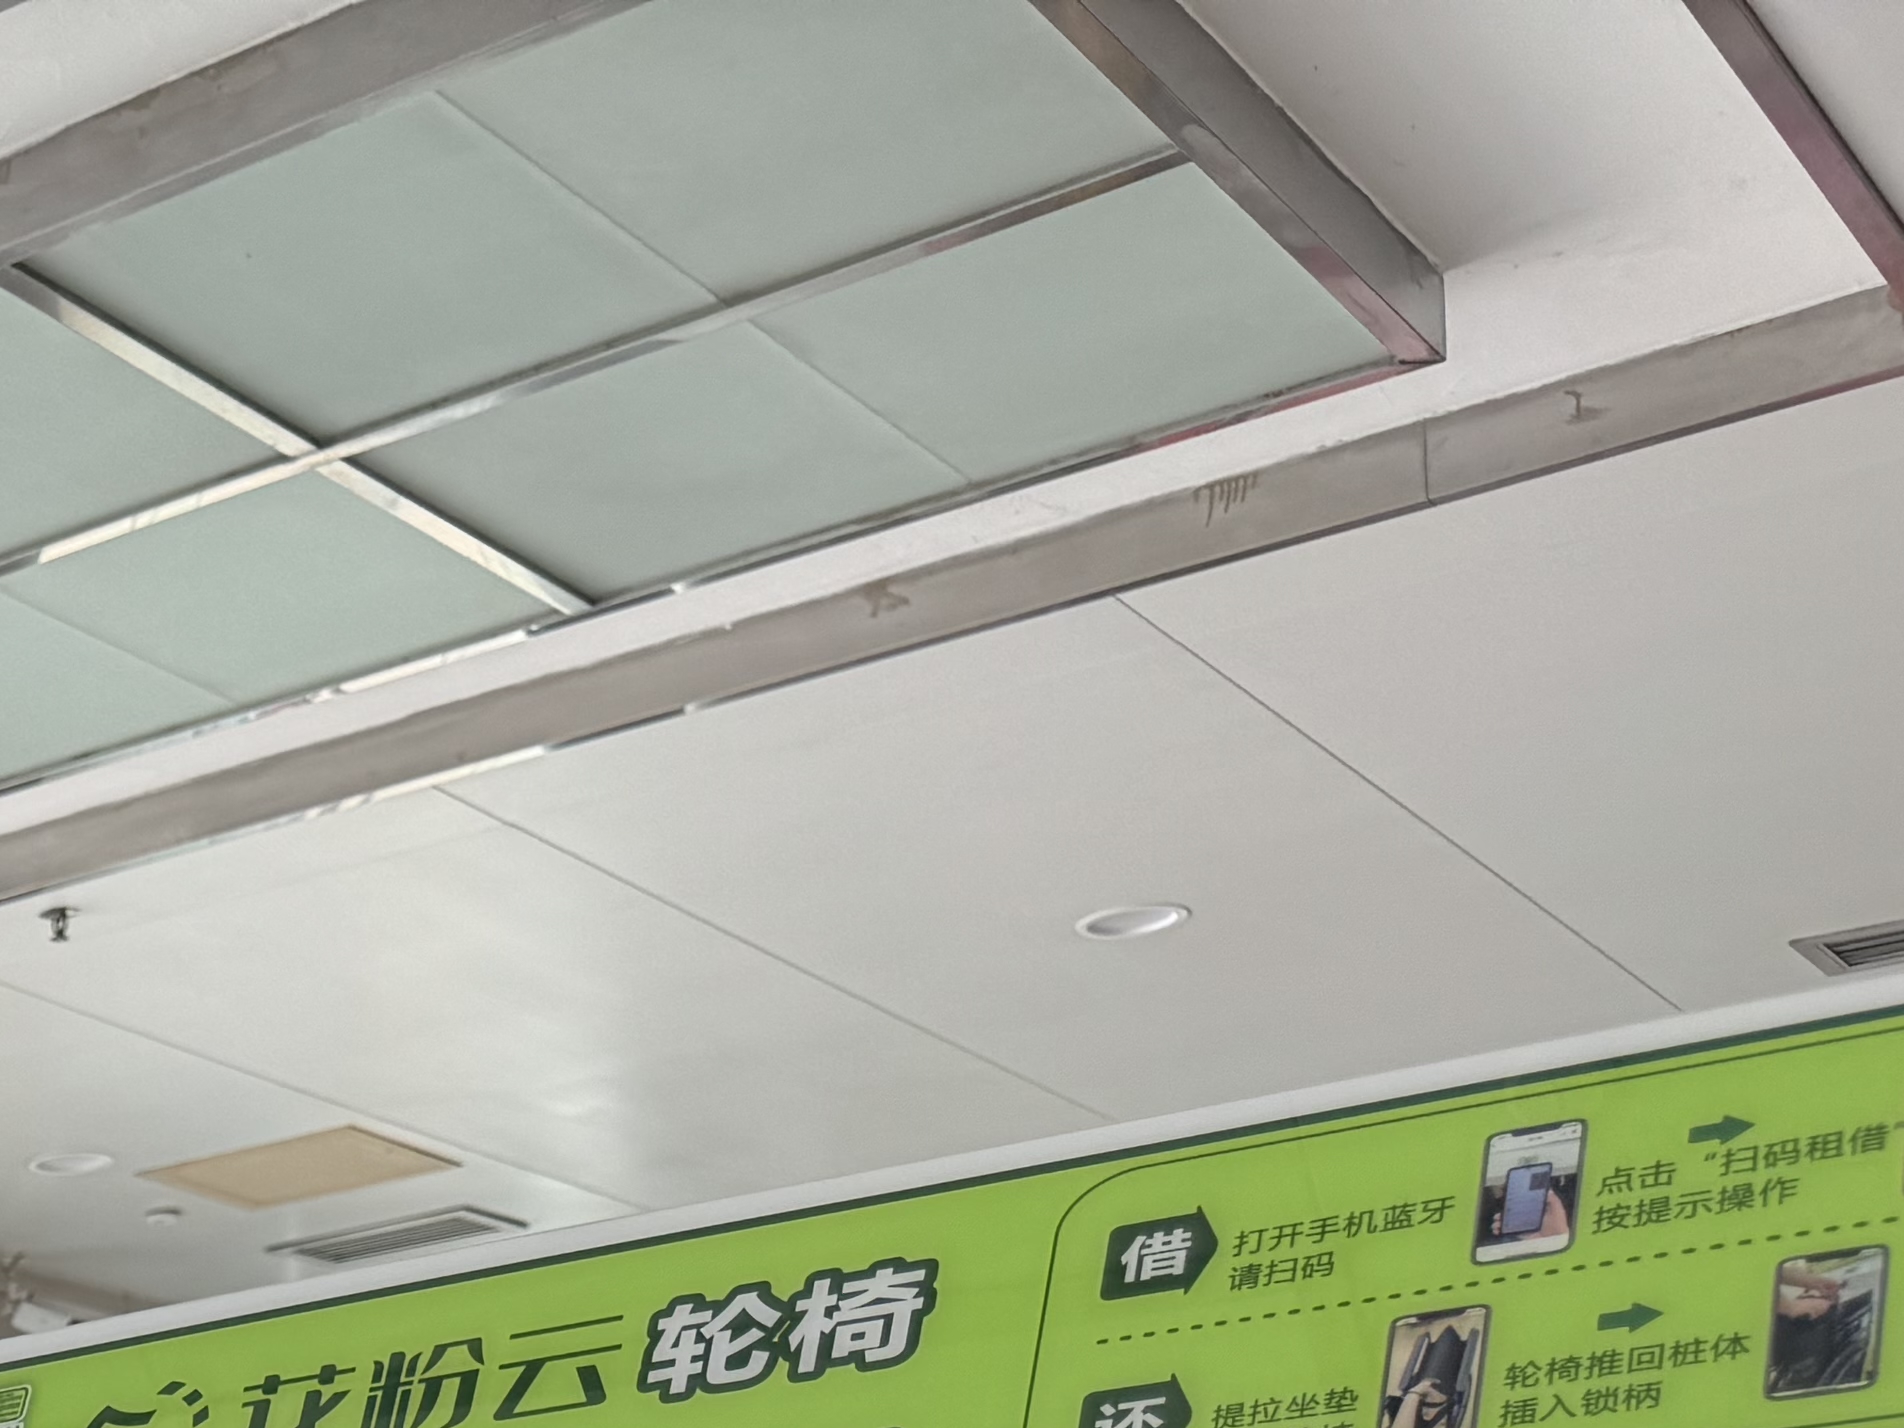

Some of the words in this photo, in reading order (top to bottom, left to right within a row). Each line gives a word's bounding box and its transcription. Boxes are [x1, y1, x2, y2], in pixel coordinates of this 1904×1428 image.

[1231, 1195, 1456, 1257] 打开手机蓝牙
[1592, 1175, 1800, 1235] 按提示操作
[1121, 1227, 1193, 1283] 借
[1227, 1250, 1336, 1292] 请扫码
[1502, 1331, 1752, 1392] 轮椅推回桩体
[1497, 1379, 1664, 1428] 插入锁柄
